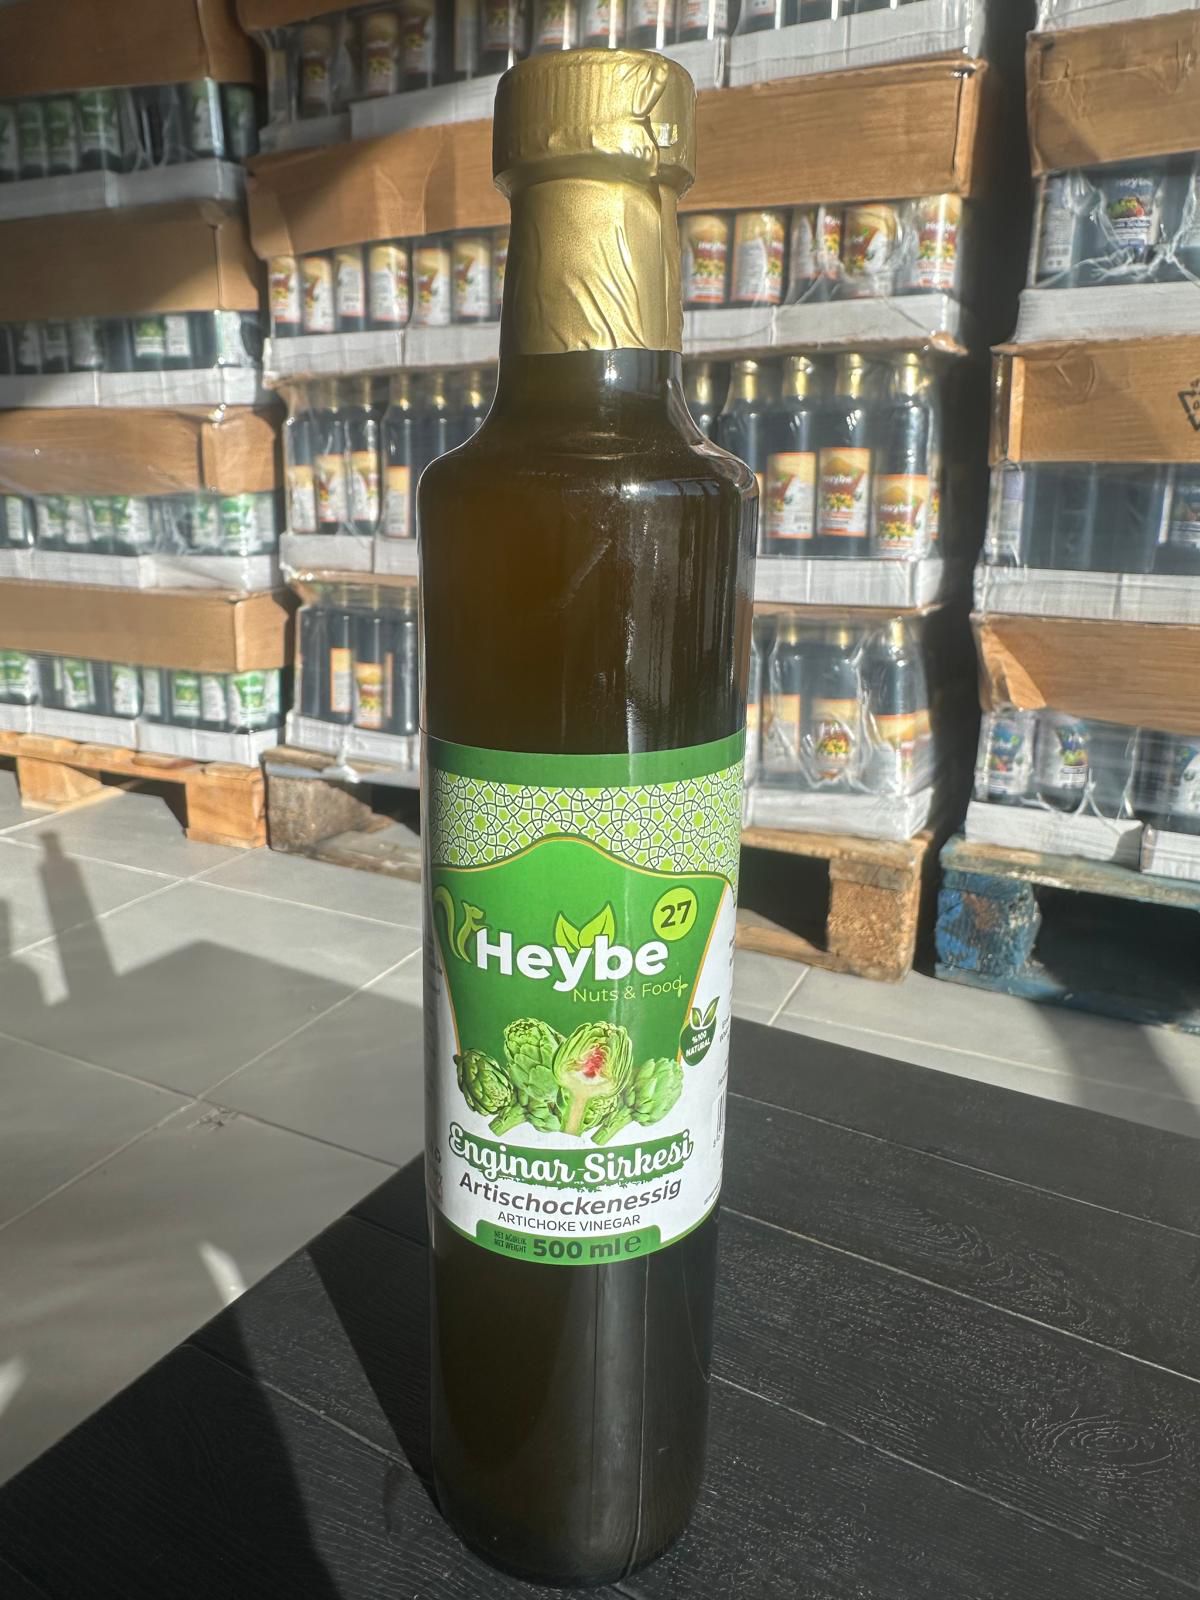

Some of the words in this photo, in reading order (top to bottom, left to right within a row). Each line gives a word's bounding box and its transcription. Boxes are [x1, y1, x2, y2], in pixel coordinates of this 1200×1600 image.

[659, 899, 693, 929] 27
[475, 928, 669, 992] Heybe
[572, 987, 619, 1003] Nuts
[623, 985, 637, 1000] &
[641, 975, 685, 998] Food
[449, 1122, 576, 1182] Enginar
[582, 1129, 695, 1184] Sirkesi
[458, 1171, 683, 1217] Artischockenessig
[497, 1210, 576, 1232] ARTICHOKE
[579, 1214, 641, 1232] VINEGAR
[533, 1238, 583, 1259] 500
